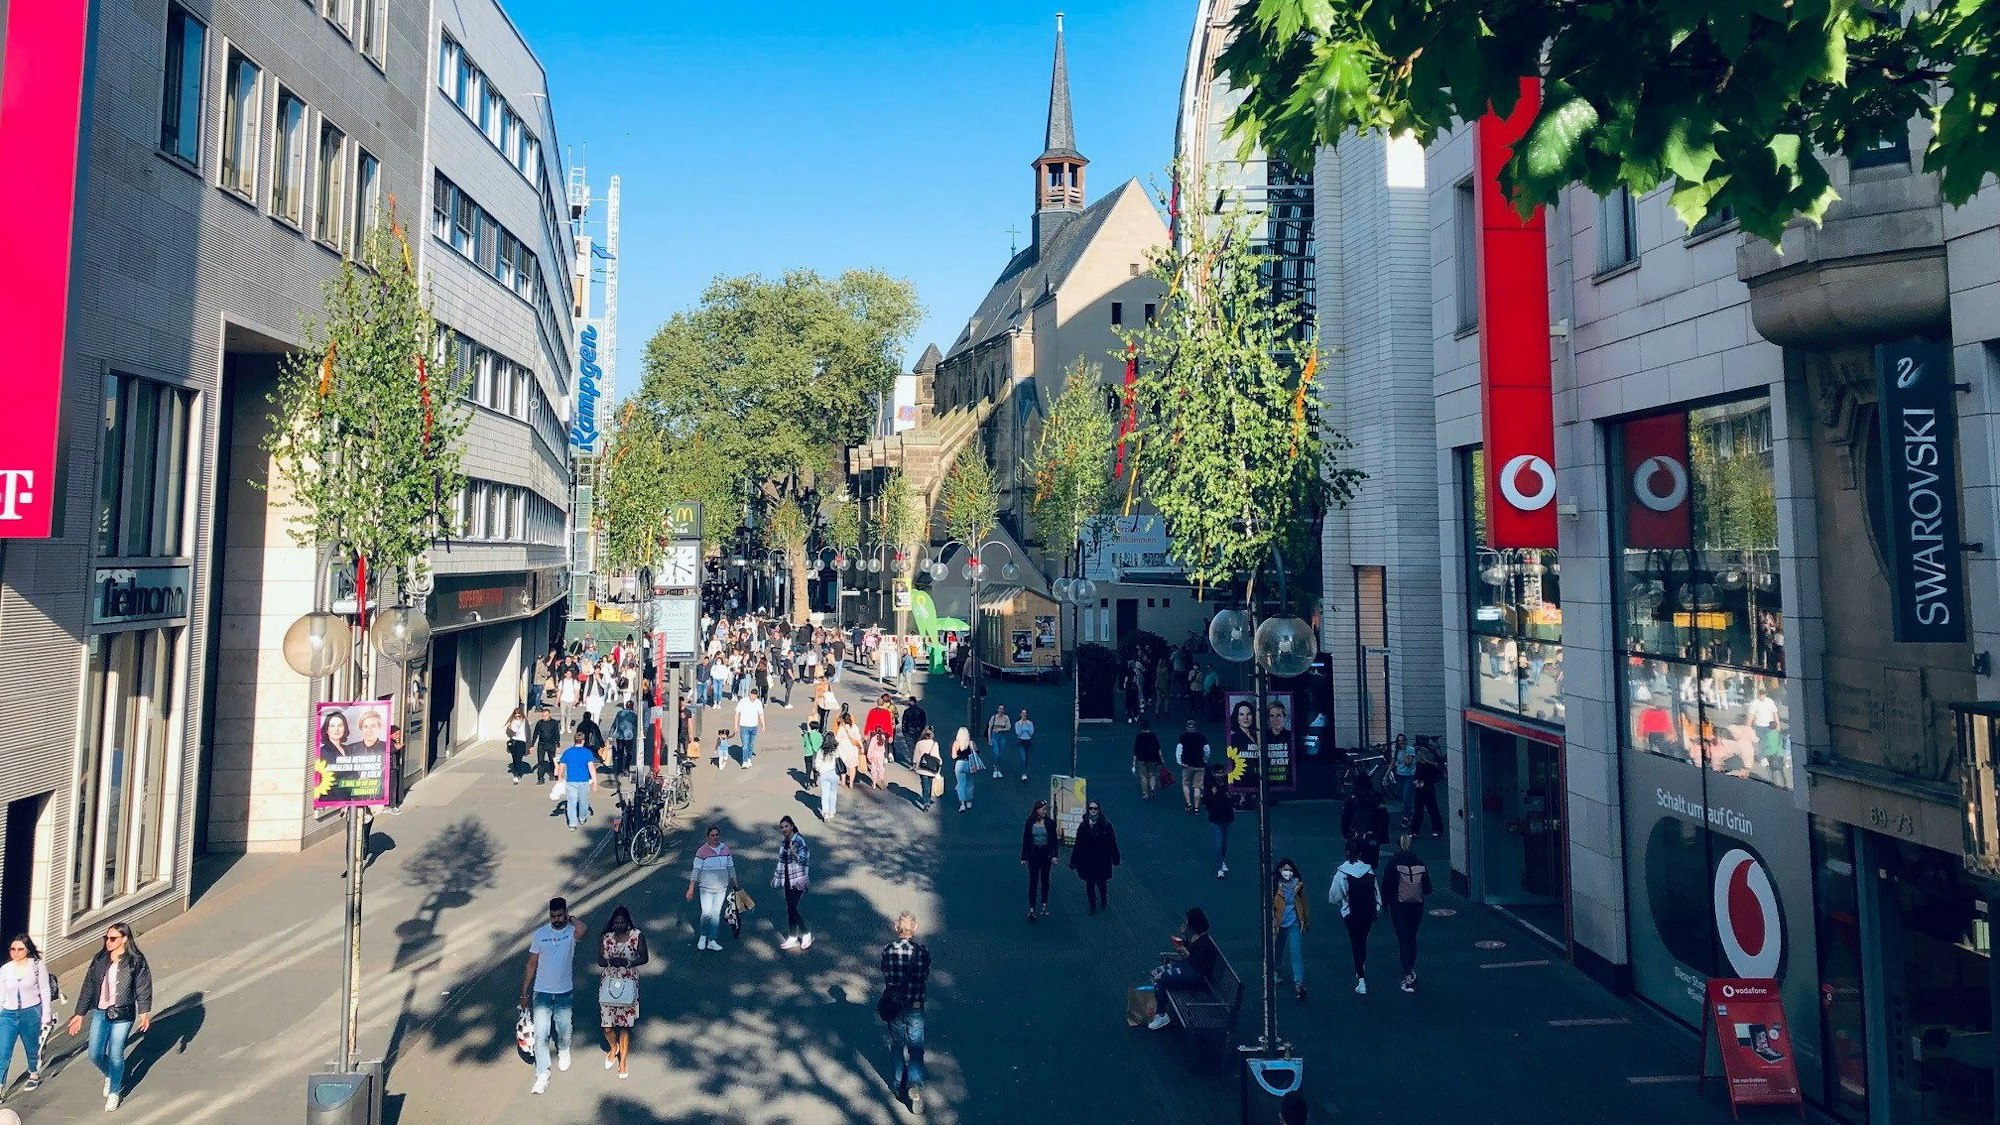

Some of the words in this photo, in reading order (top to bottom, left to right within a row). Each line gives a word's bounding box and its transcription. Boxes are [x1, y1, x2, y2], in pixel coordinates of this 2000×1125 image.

[570, 324, 602, 452] Kämpgen
[1902, 407, 1951, 626] SWAROVSKI
[100, 577, 184, 619] fielmann
[1656, 788, 1686, 814] Schalt
[1687, 801, 1704, 820] um
[1707, 807, 1725, 826] auf
[1726, 808, 1753, 836] Grün
[1735, 986, 1767, 995] vodafone
